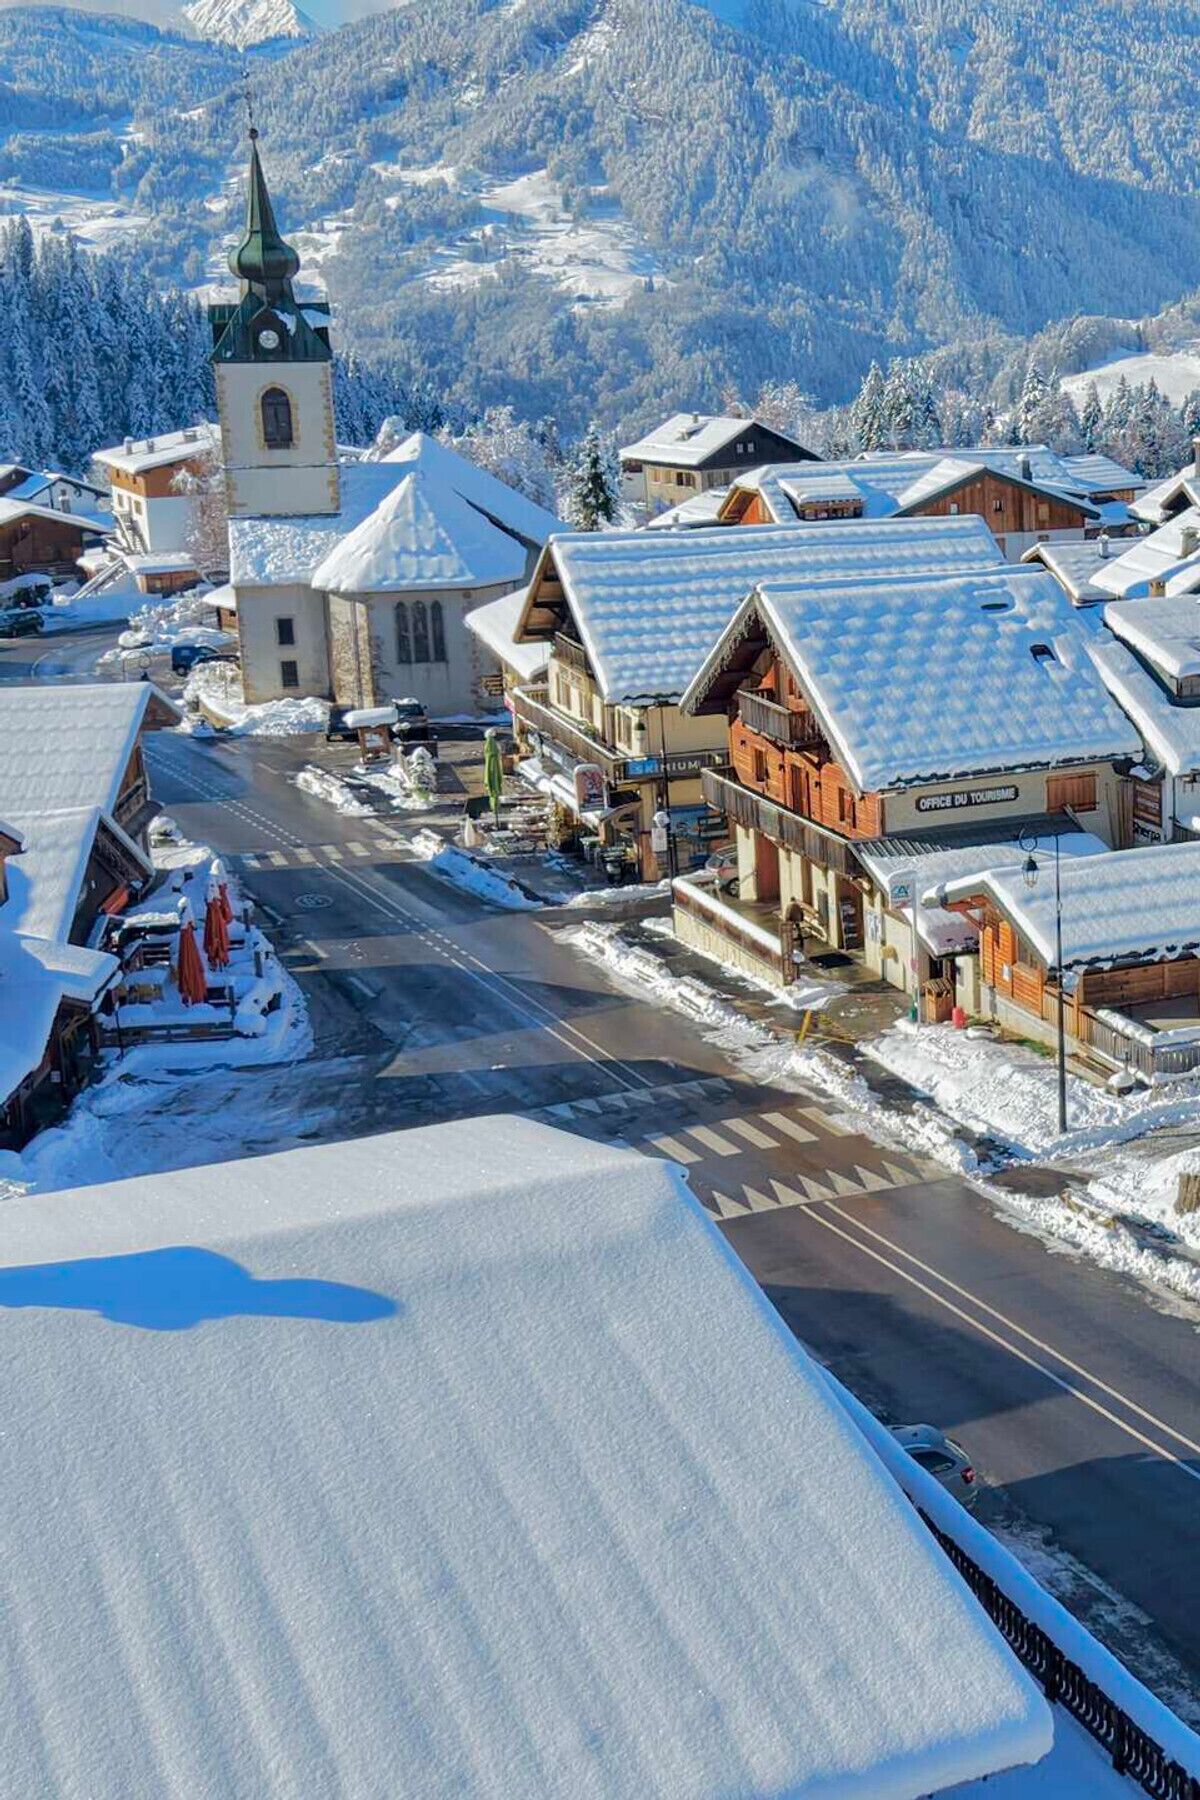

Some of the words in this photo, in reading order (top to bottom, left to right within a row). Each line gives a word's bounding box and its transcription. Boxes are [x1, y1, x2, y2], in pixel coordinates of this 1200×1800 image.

[920, 794, 952, 810] OFFICE
[954, 793, 968, 806] DU
[970, 787, 1015, 803] TOURISME
